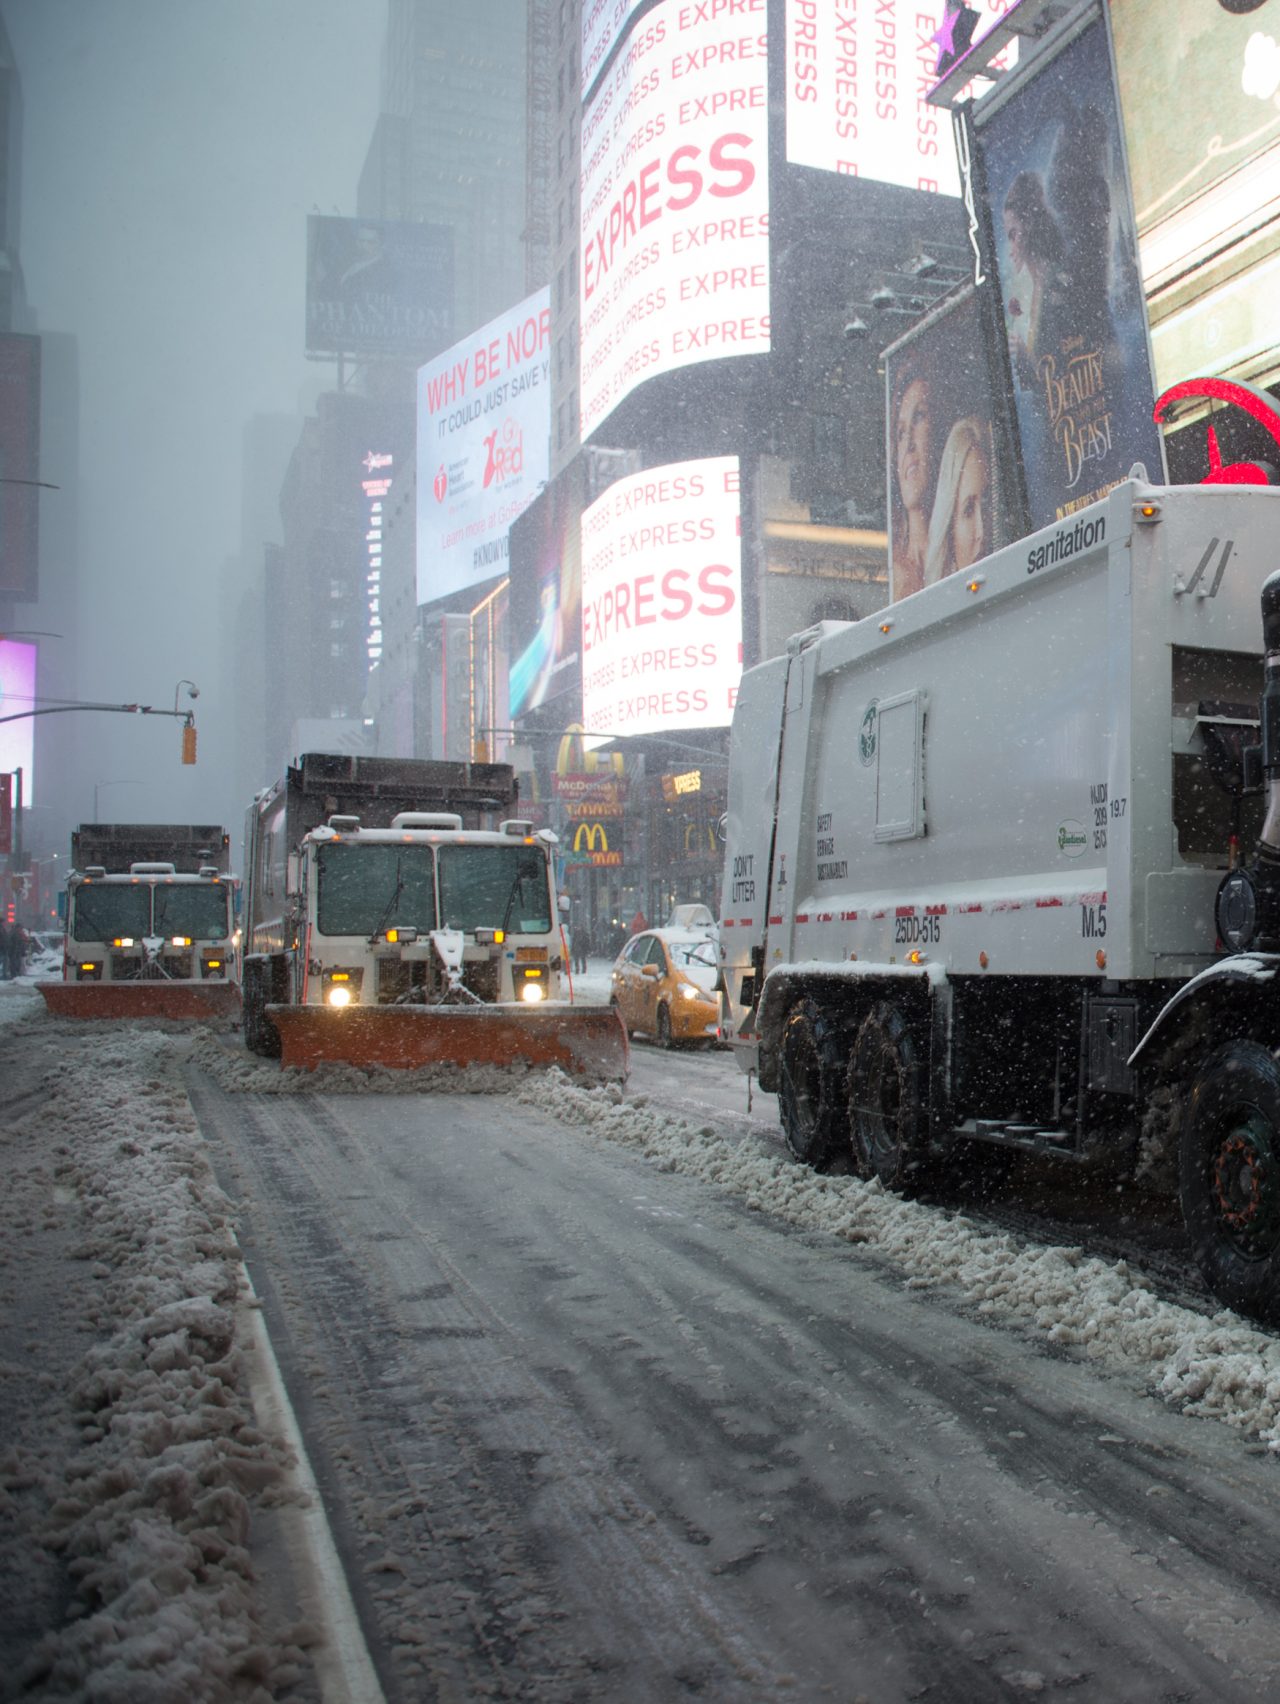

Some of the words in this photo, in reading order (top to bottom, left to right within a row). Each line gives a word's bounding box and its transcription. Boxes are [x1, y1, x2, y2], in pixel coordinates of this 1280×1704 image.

[616, 20, 666, 92] EXPRESS
[614, 68, 660, 138] EXPRESS
[615, 113, 666, 179] EXPRESS
[678, 85, 765, 125] EXPRE
[584, 132, 756, 302] EXPRESS
[613, 241, 660, 301] EXPRESS
[616, 287, 667, 345] EXPRESS
[679, 264, 766, 301] EXPRE
[427, 357, 469, 416] WHY
[474, 338, 501, 389] BE
[438, 418, 447, 438] IT
[448, 399, 481, 432] COULD
[483, 382, 509, 414] JUST
[511, 365, 540, 398] SAVE
[615, 475, 705, 517] EXPRESS
[620, 518, 715, 557] EXPRESS
[1027, 516, 1106, 575] sanitation
[583, 564, 736, 652] EXPRESS
[621, 643, 717, 679] EXPRESS
[618, 689, 708, 722] EXPRESS
[1110, 798, 1127, 818] 19.7
[732, 881, 756, 903] LITTER
[734, 855, 754, 878] DON'T
[1082, 904, 1107, 938] M.5
